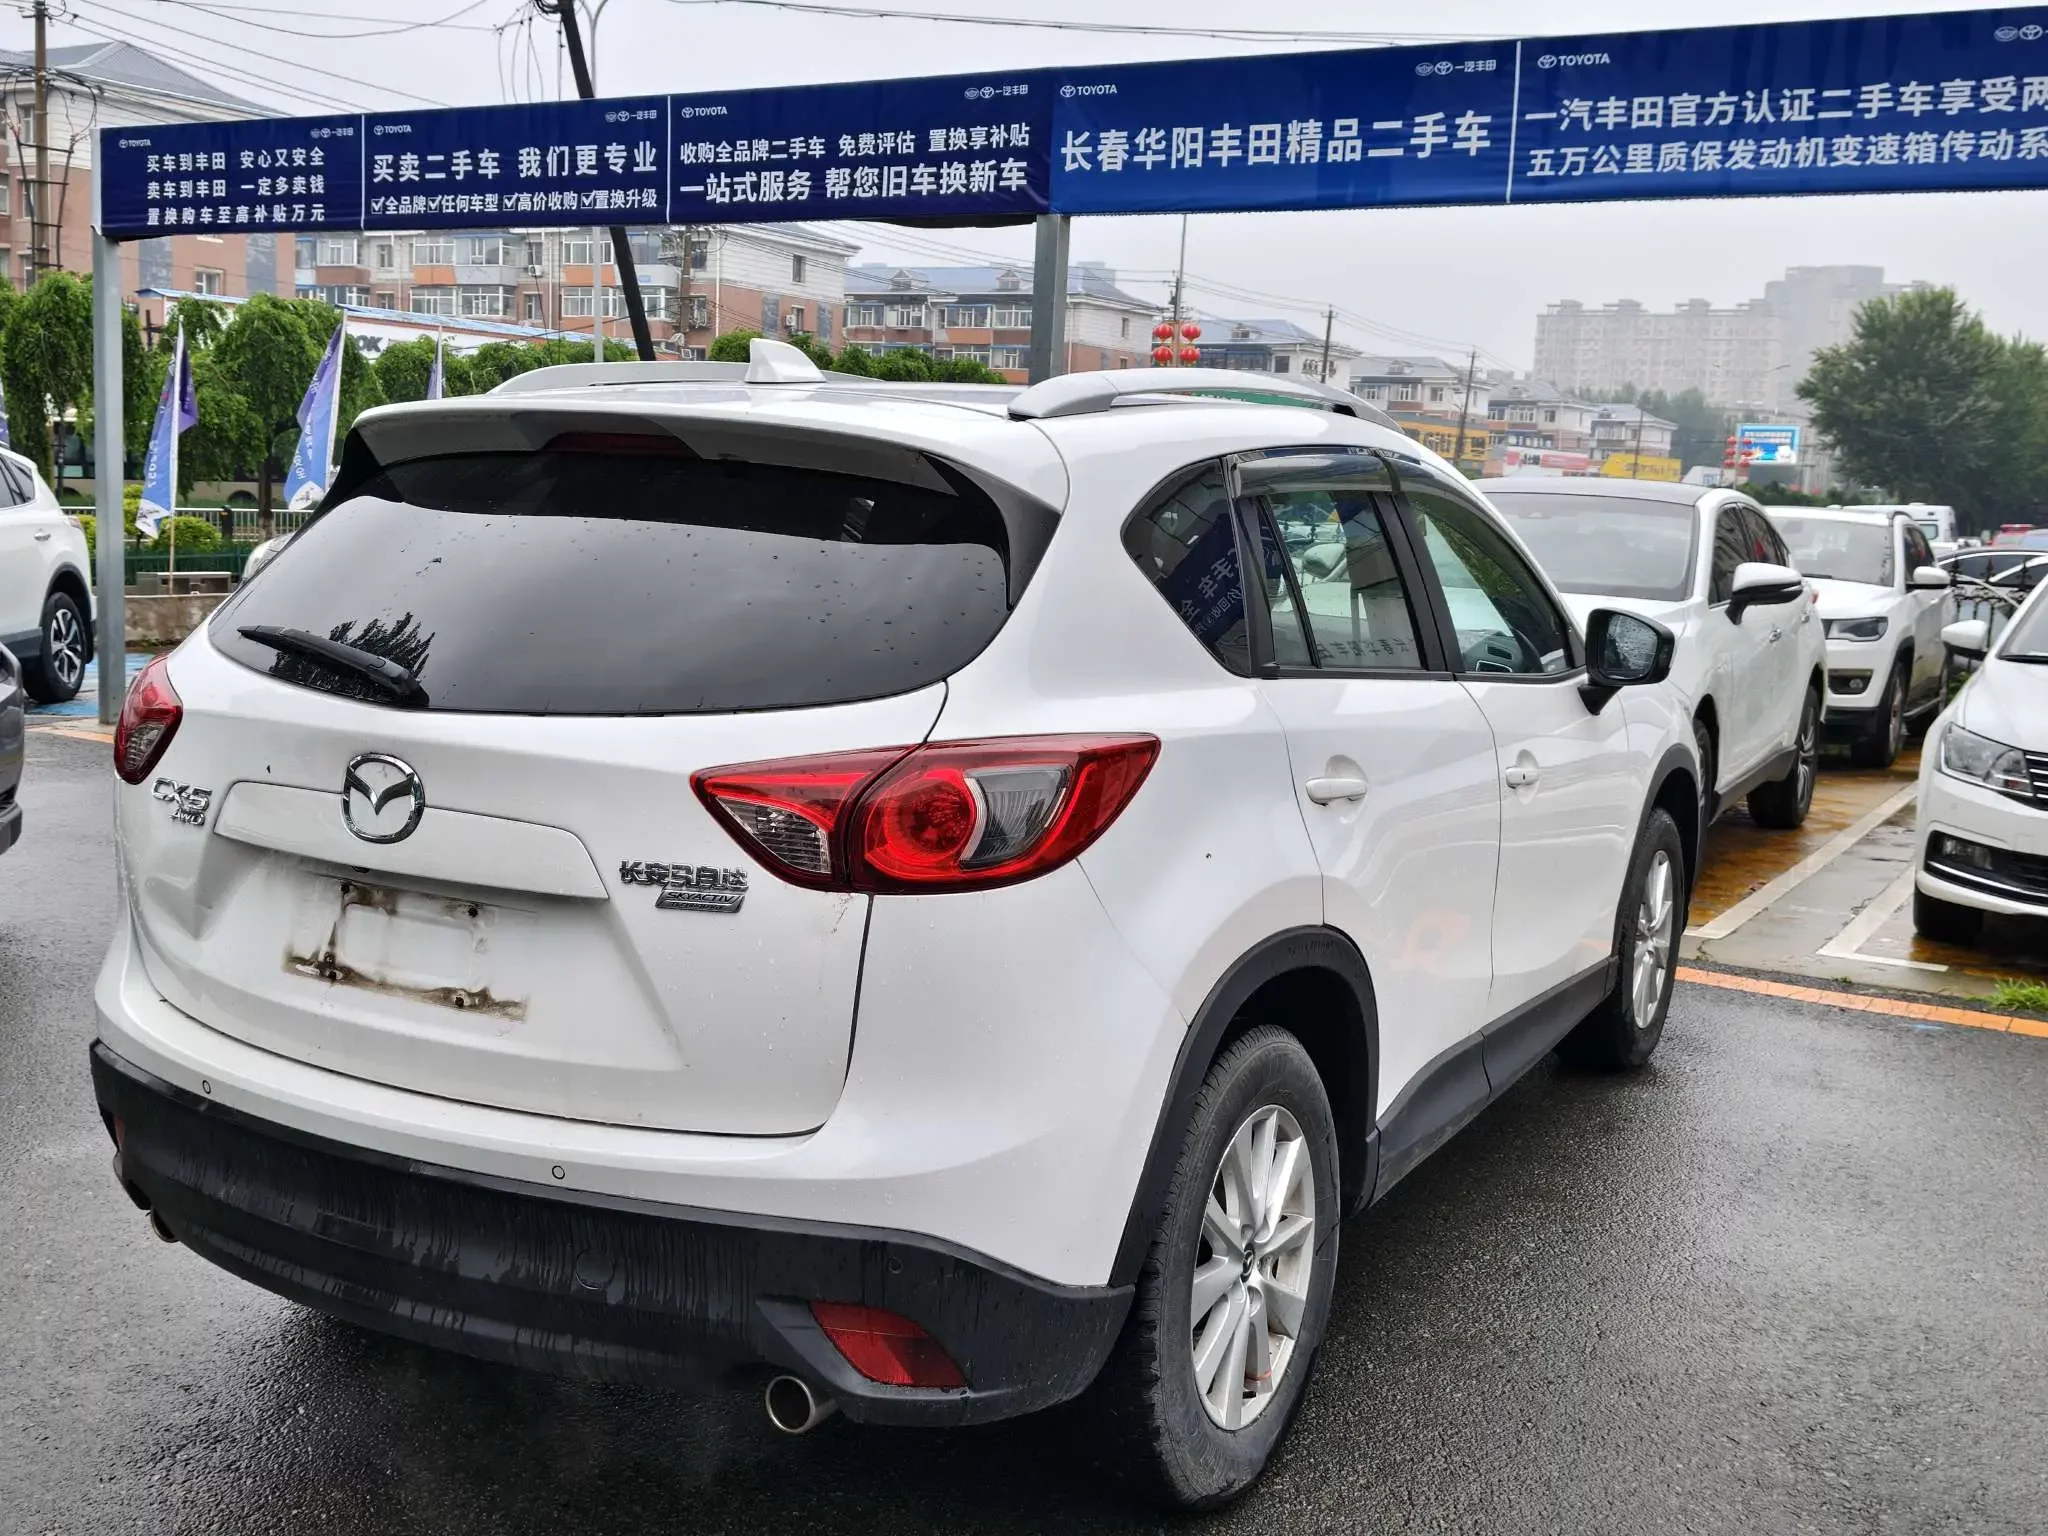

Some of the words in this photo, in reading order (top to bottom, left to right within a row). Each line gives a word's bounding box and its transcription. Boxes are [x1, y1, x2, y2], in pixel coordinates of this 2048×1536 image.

[1558, 52, 1611, 66] TOYOTA
[1076, 84, 1118, 96] TOYOTA
[694, 106, 728, 117] TOYOTA
[1524, 75, 2048, 132] 一汽丰田官方认证二手车享受两
[383, 124, 412, 134] TOYOTA
[1060, 109, 1492, 172] 长春华阳丰田精品二手车
[126, 138, 152, 148] TOYOTA
[680, 135, 826, 165] 收购全品牌二手车
[838, 130, 916, 157] 免费评估
[928, 122, 1030, 152] 置换享补贴
[1526, 126, 2048, 177] 五万公里质保发动机变速箱传动系
[146, 151, 226, 173] 买车到丰田
[239, 146, 325, 169] 安心又安全
[373, 148, 501, 183] 买卖二手车
[518, 140, 657, 178] 我们更专业
[147, 179, 226, 200] 卖车到丰田
[240, 174, 325, 196] 一定多卖钱
[679, 169, 812, 204] 一站式服务
[824, 157, 1028, 200] 帮您旧车换新车
[384, 194, 427, 215] 全品牌
[441, 193, 499, 214] 任何车型
[516, 190, 578, 212] 高价收购
[593, 187, 657, 210] 置换升级
[146, 203, 325, 226] 置换购车至高补贴万元
[170, 809, 205, 826] AWD
[667, 891, 734, 904] SKYACTIV
